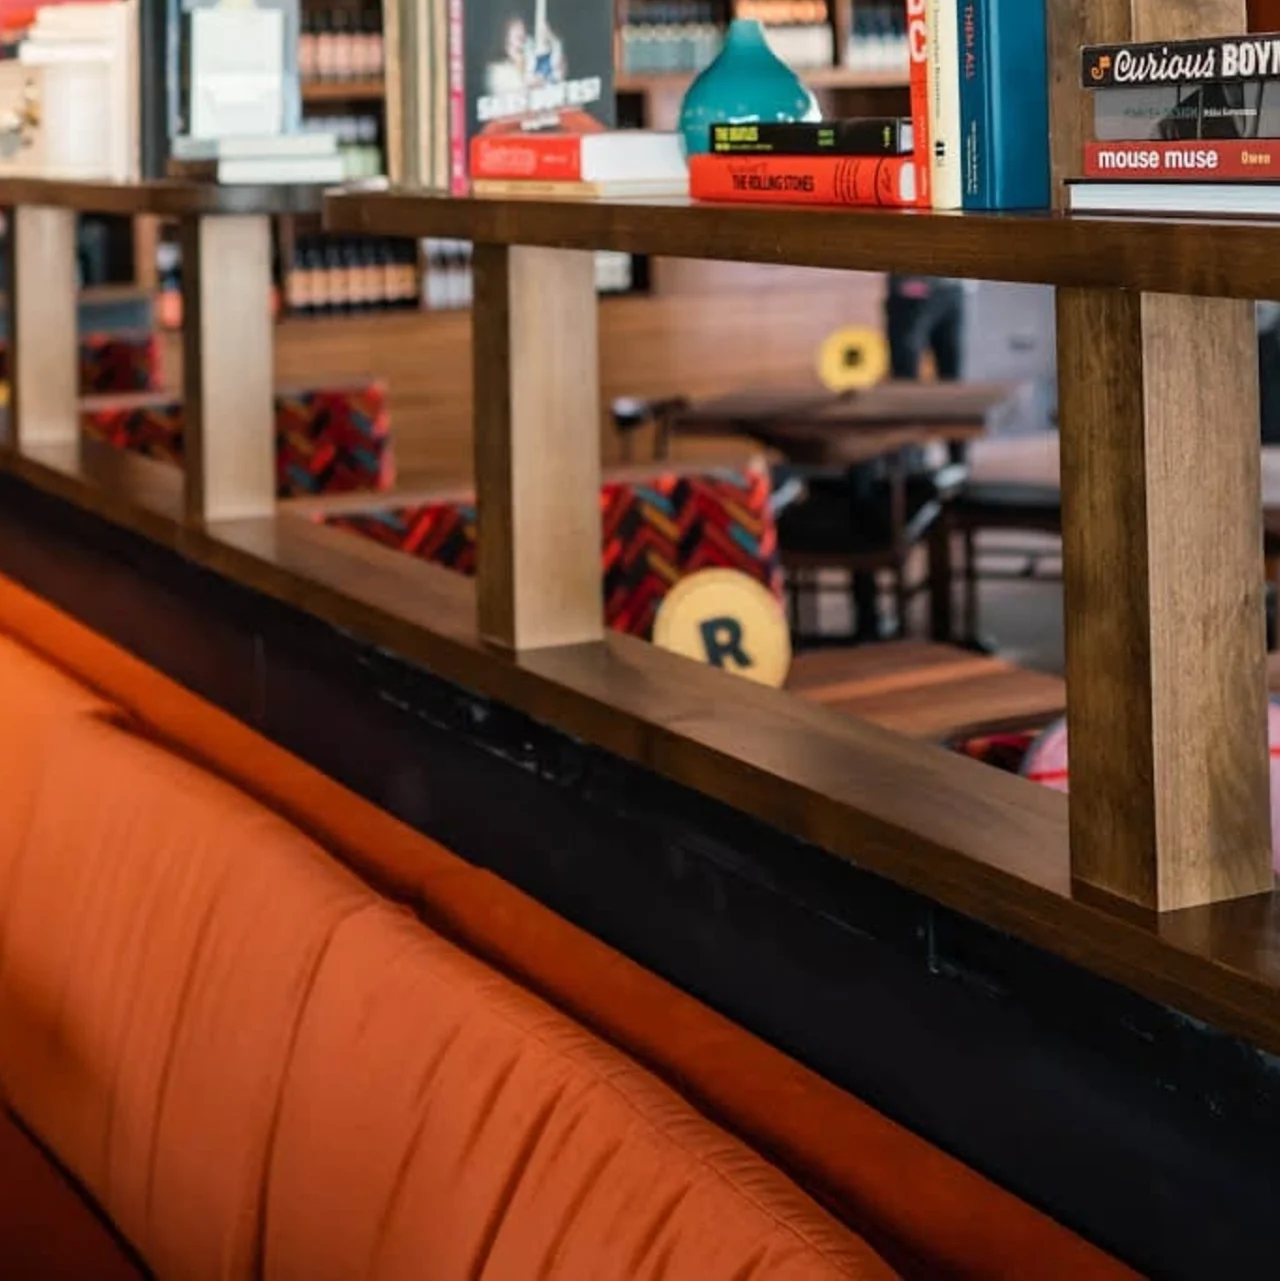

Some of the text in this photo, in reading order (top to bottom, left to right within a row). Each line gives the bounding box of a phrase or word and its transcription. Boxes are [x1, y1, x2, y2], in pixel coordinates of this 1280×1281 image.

[963, 6, 975, 50] THEM
[964, 52, 975, 79] ALL
[1113, 46, 1215, 83] Curious
[1098, 147, 1271, 170] mouse muse Owen
[732, 174, 815, 193] THE ROLLING STONES
[699, 616, 754, 669] R
